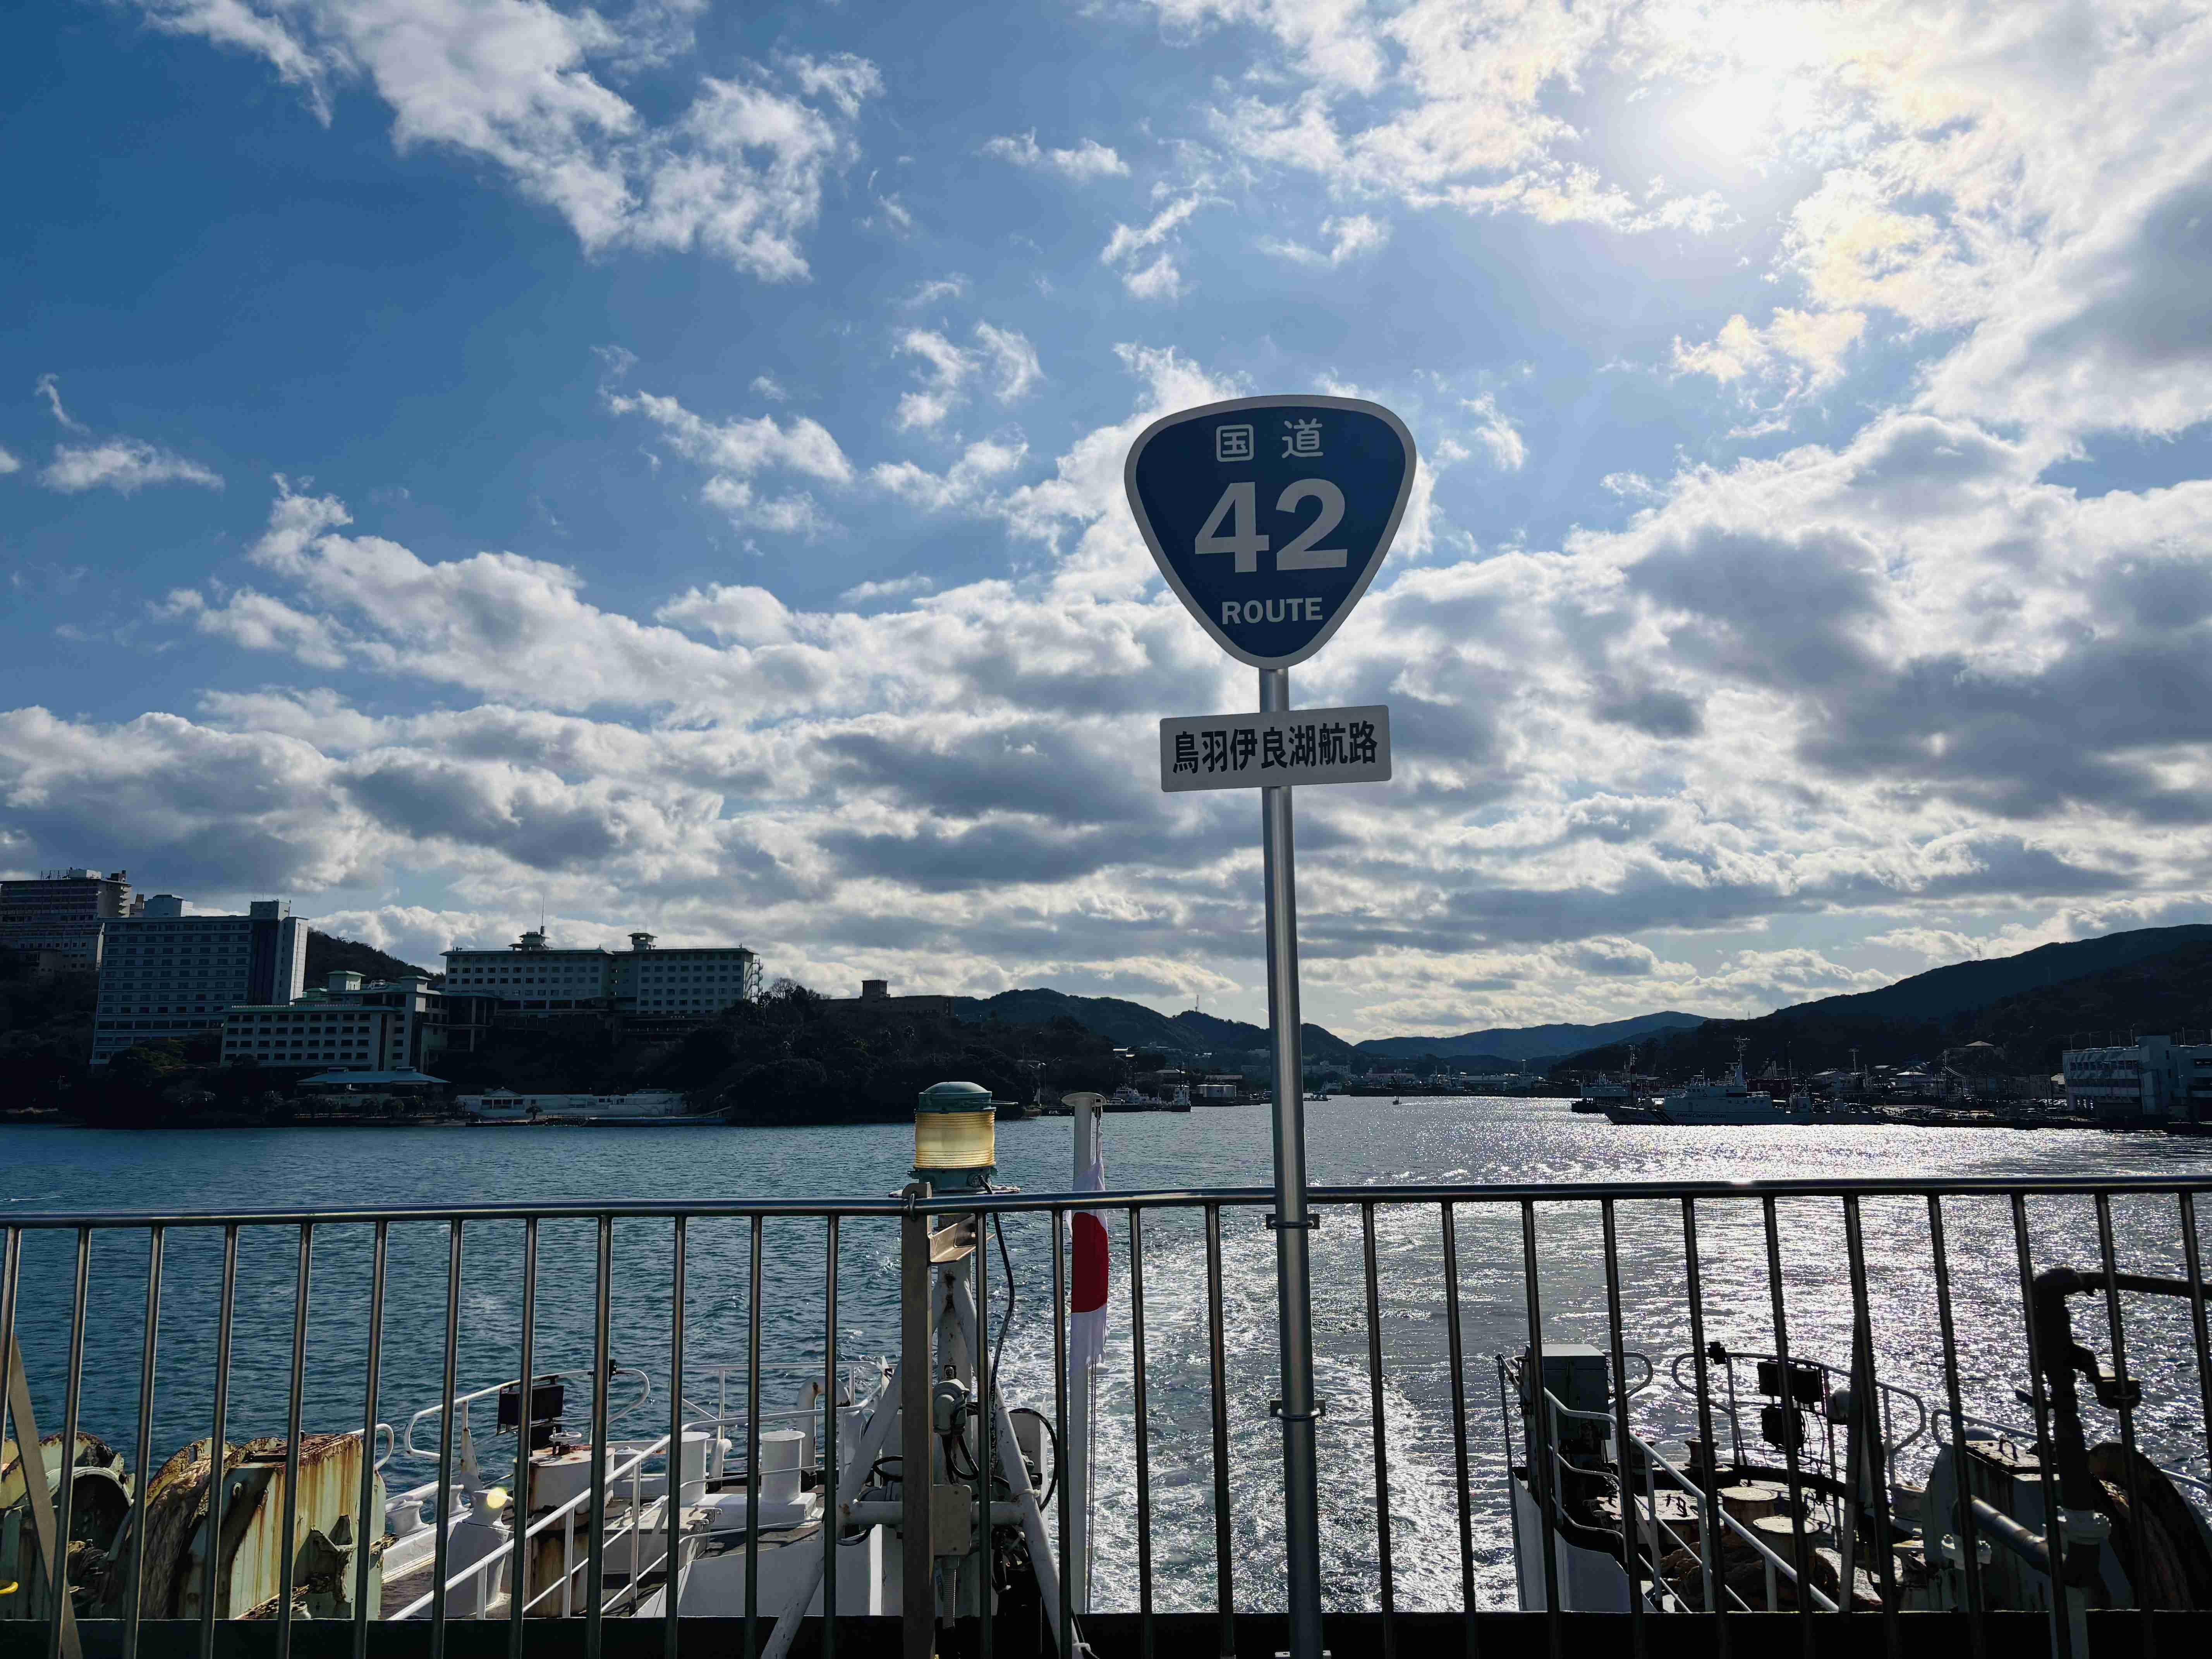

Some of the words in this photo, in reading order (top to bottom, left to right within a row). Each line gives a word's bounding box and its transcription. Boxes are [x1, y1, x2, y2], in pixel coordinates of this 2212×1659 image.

[1216, 418, 1324, 462] 国道
[1195, 478, 1348, 573] 42
[1222, 597, 1323, 625] ROUTE
[1172, 720, 1378, 774] 鳥羽伊良湖航路
